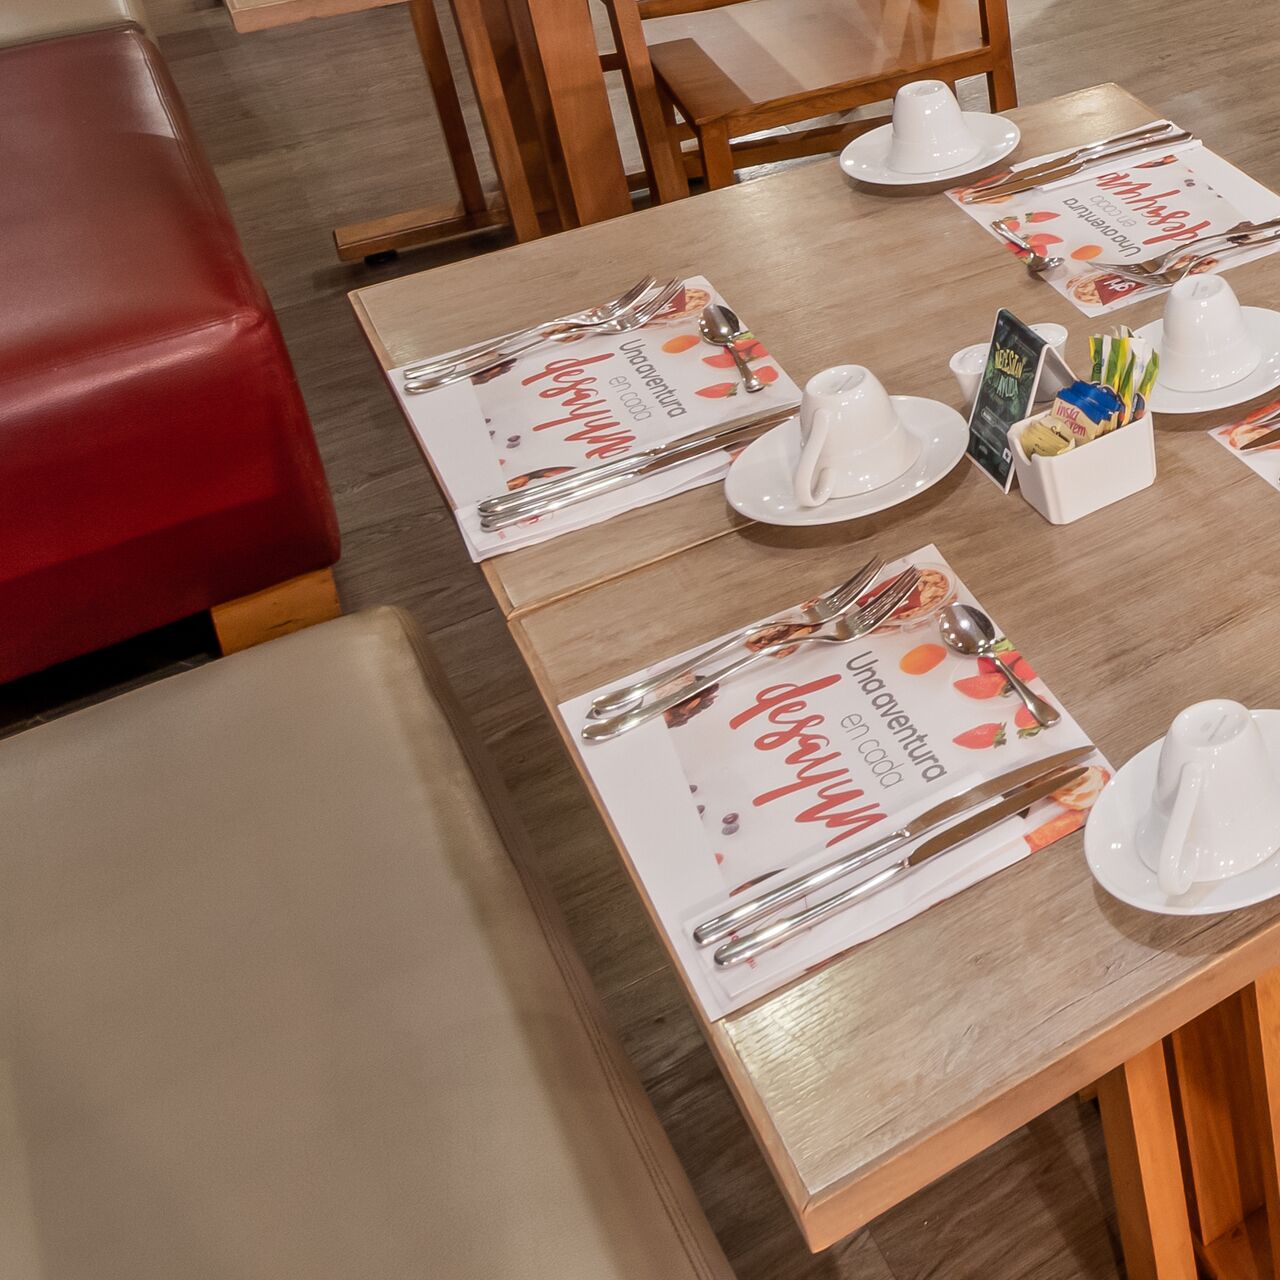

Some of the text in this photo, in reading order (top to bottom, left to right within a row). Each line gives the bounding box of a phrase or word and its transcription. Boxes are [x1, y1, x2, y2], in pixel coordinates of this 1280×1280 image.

[1062, 197, 1142, 258] Una aventura
[608, 375, 652, 421] en cada
[619, 338, 647, 366] Una
[635, 361, 688, 418] aventura
[840, 712, 905, 791] en cada
[845, 650, 948, 784] Una aventura
